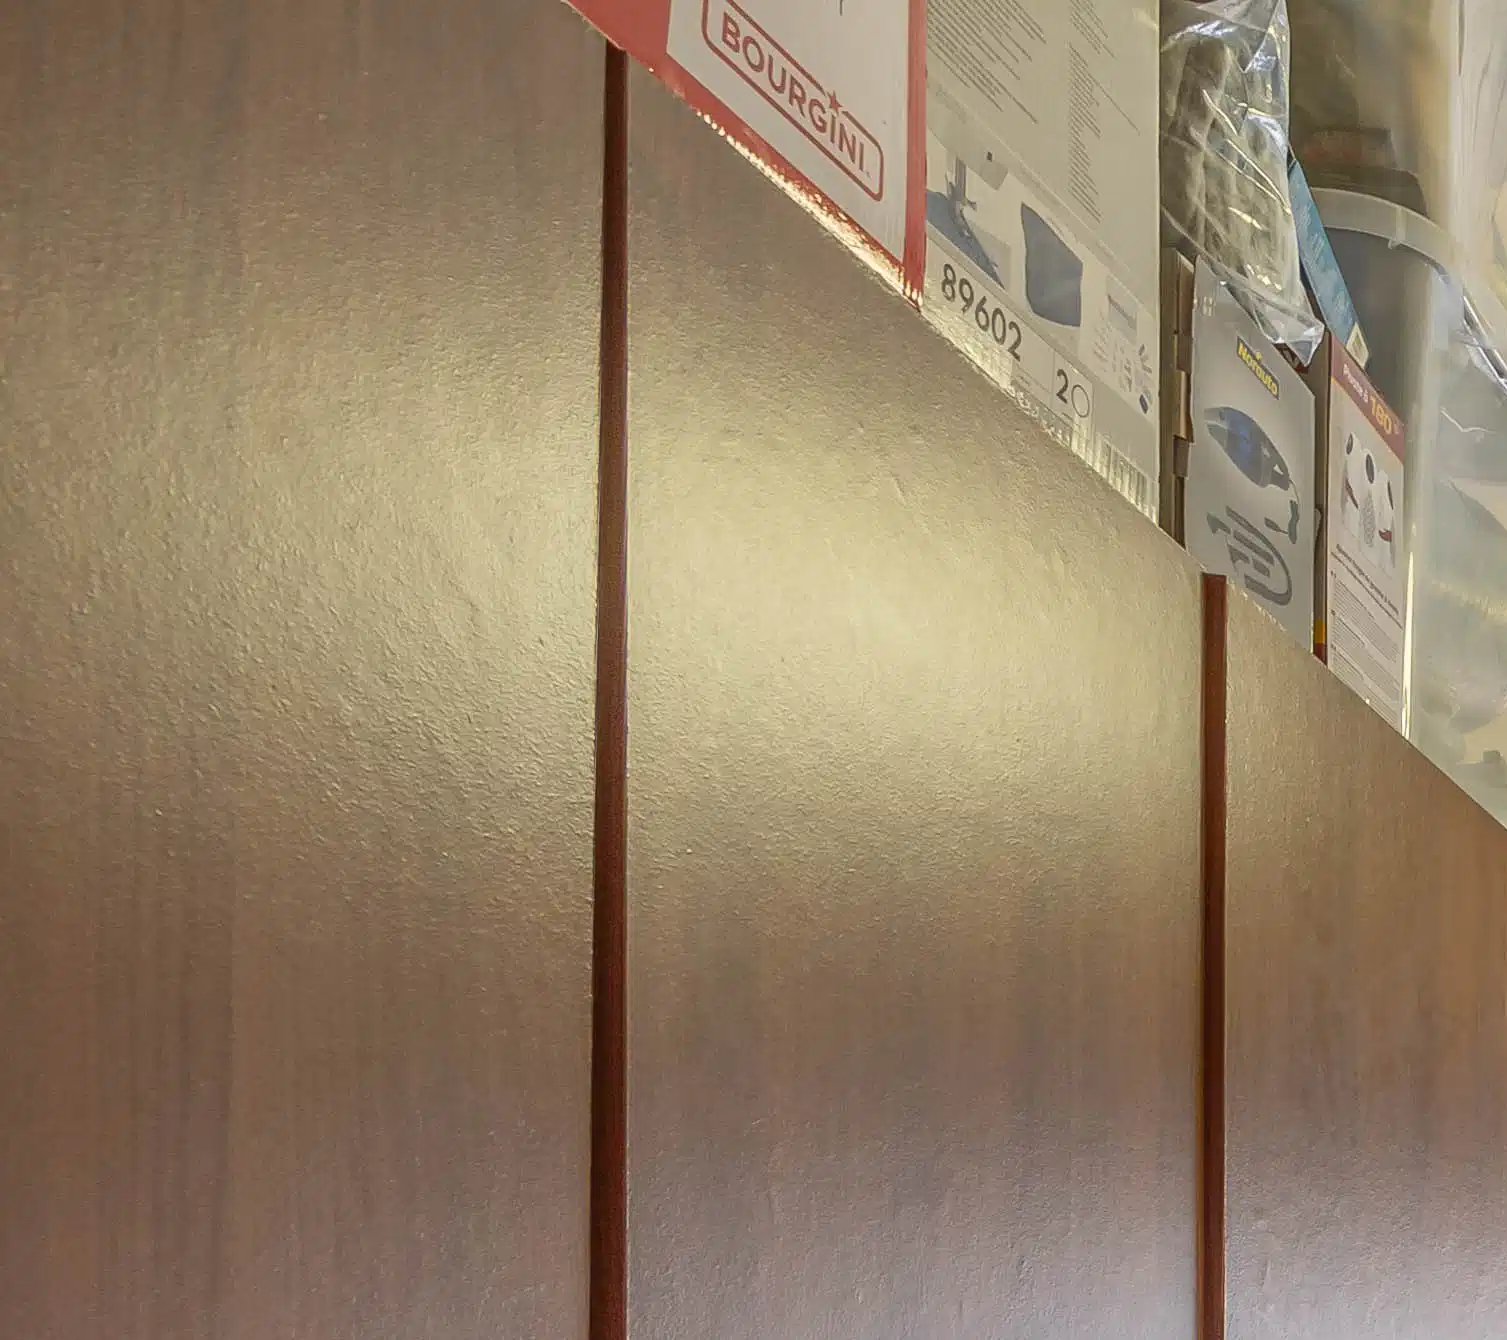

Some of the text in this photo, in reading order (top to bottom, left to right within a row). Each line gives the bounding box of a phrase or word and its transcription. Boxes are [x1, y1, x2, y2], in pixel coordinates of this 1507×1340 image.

[721, 11, 866, 174] BOURGINI
[941, 263, 1022, 361] 89602
[1236, 343, 1278, 397] Norauto
